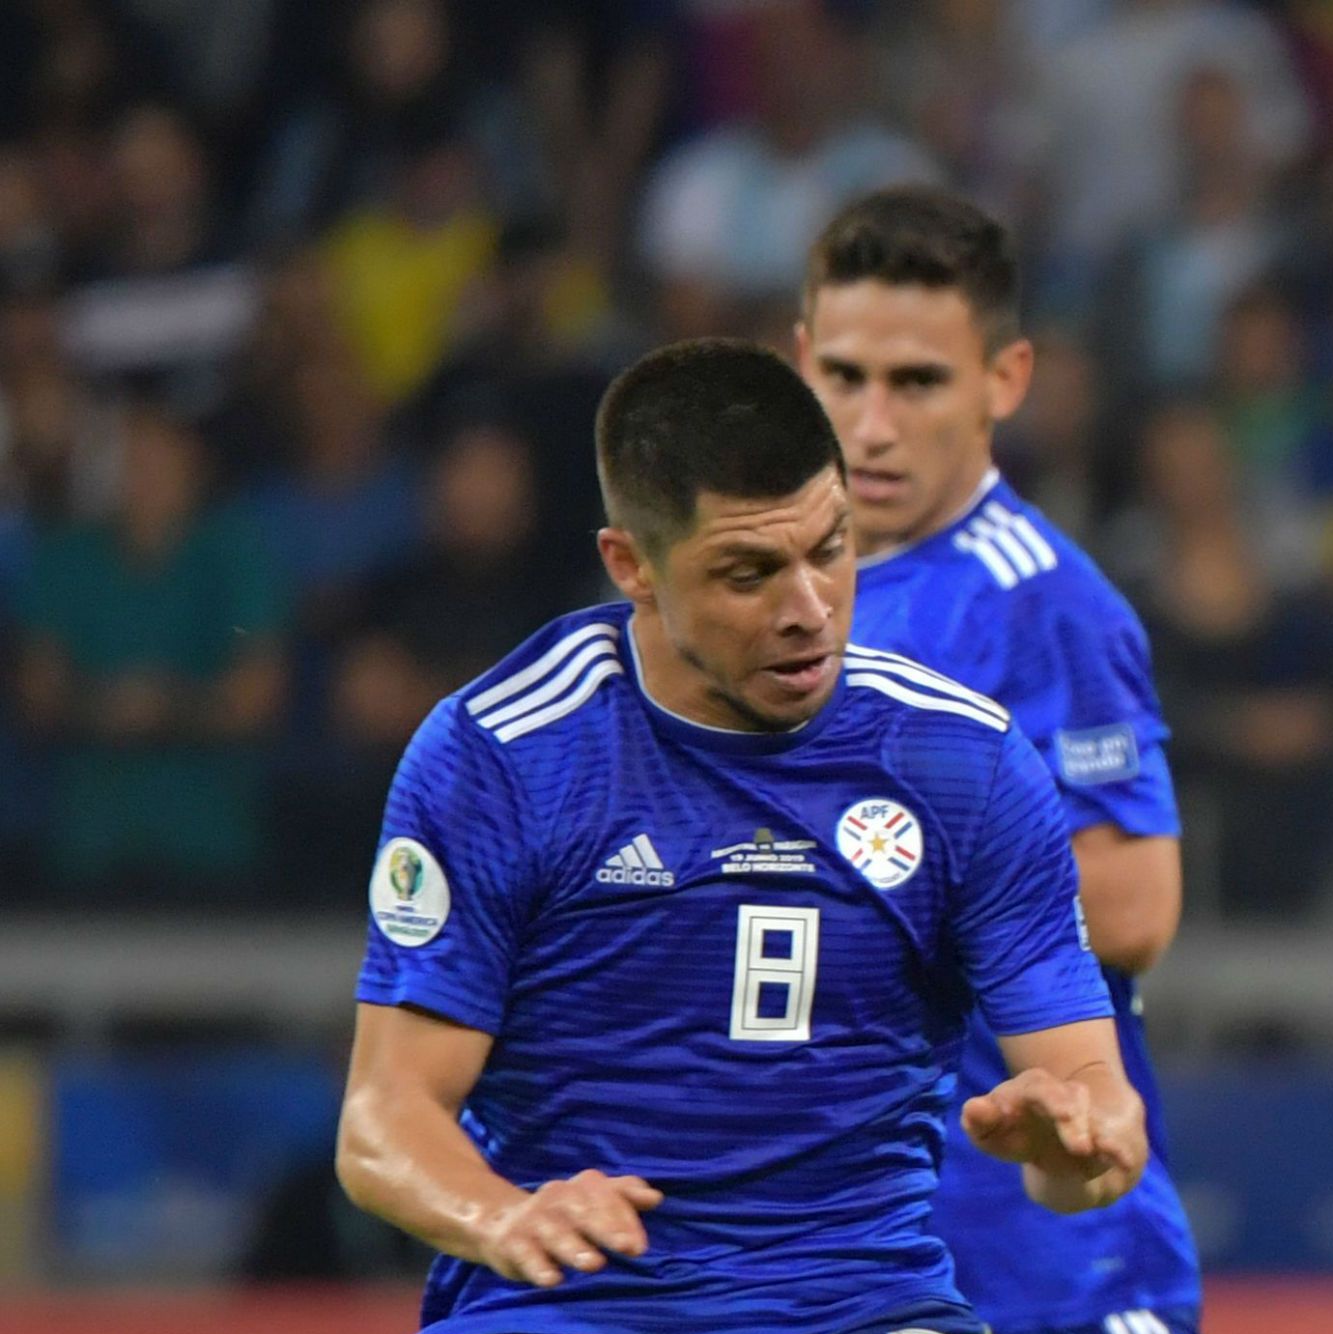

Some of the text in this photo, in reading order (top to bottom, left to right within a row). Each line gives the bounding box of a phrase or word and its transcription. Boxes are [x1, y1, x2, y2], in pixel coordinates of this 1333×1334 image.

[861, 805, 889, 819] APF
[596, 867, 675, 887] adidas
[729, 905, 820, 1041] 8
